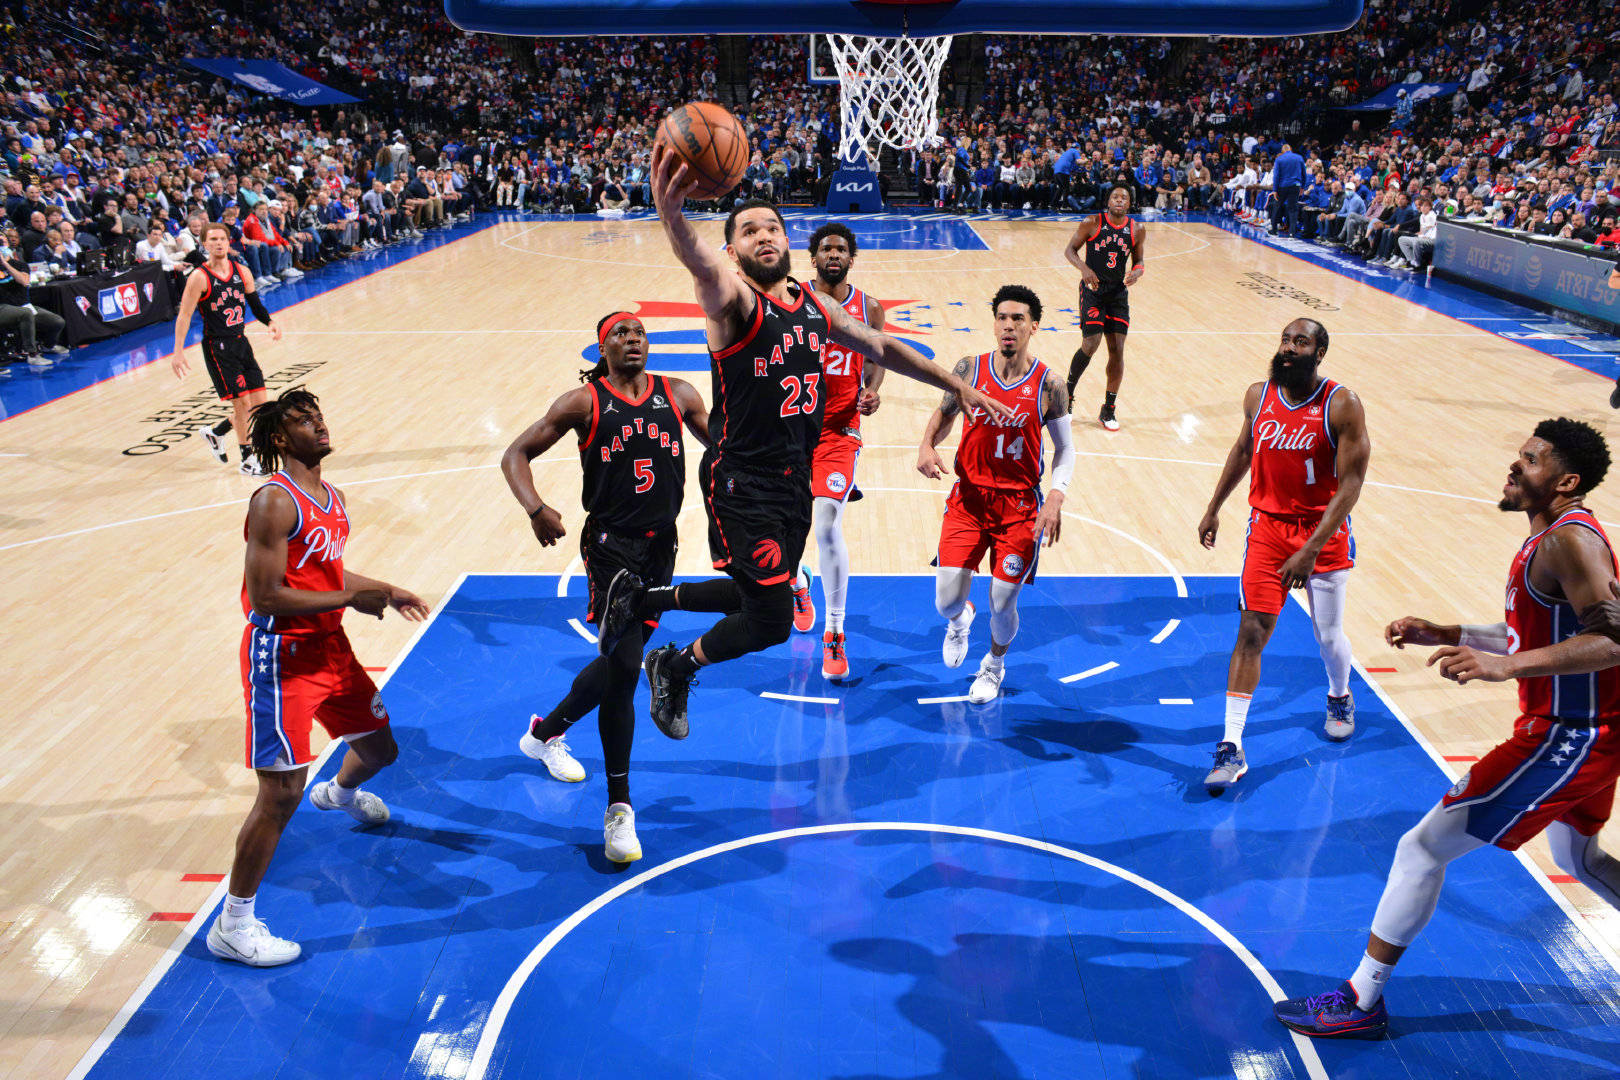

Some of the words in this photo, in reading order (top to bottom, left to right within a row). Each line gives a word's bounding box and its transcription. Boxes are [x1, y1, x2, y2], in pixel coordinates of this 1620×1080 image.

[1106, 251, 1118, 269] 3
[1465, 246, 1495, 271] AT&T
[1492, 253, 1513, 276] 5G
[1555, 269, 1593, 299] AT&T
[223, 305, 244, 327] 22
[825, 350, 853, 376] 21
[779, 372, 820, 418] 23
[600, 417, 680, 462] RAPTORS
[994, 433, 1025, 461] 14
[1256, 419, 1317, 454] Phila
[633, 458, 656, 494] 5
[1304, 457, 1316, 485] 1
[296, 525, 347, 570] Phila
